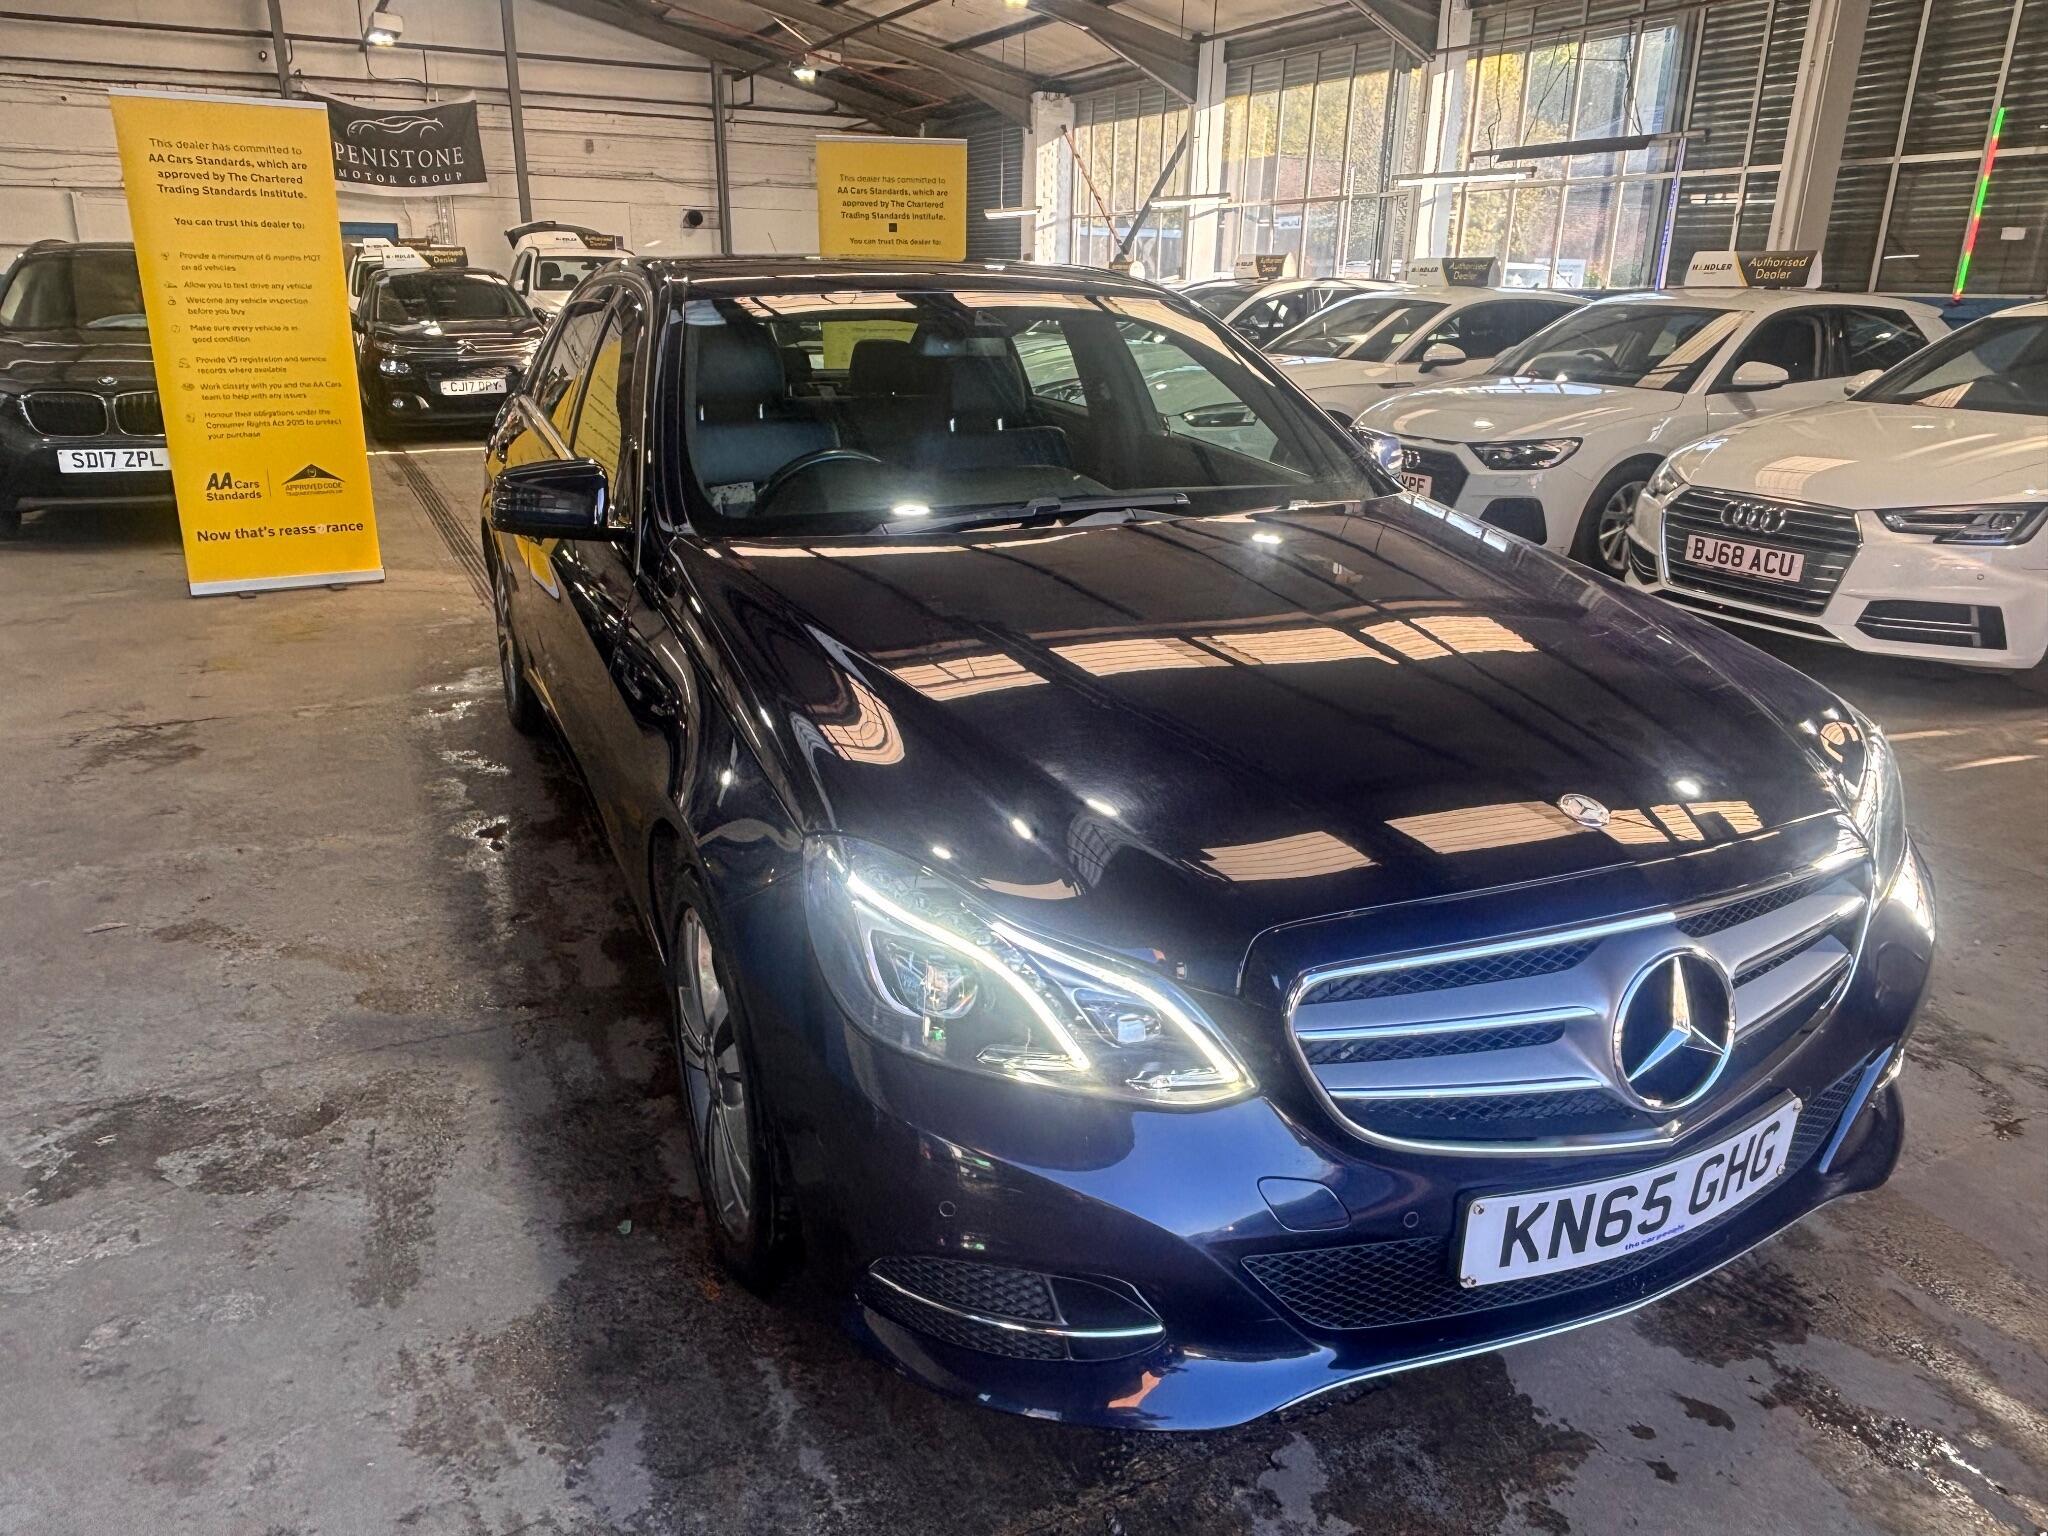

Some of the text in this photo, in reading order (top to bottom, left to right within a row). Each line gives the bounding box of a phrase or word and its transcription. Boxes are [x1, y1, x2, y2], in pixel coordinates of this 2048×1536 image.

[149, 138, 302, 155] This dealer has committed to
[149, 154, 165, 163] AA
[168, 155, 193, 165] Cars
[196, 156, 255, 168] Standards,
[257, 160, 289, 169] which
[334, 142, 464, 168] PENISTONE
[158, 171, 303, 184] approved by The Chartered
[338, 168, 463, 184] MOTOR GROUP
[840, 174, 855, 182] This
[157, 184, 308, 198] Trading Standards Institute.
[870, 188, 911, 196] Standards,
[842, 200, 878, 208] approved
[880, 200, 889, 209] by
[890, 200, 905, 208] The
[841, 212, 869, 220] Trading
[872, 212, 910, 220] Standards
[174, 218, 193, 226] You
[216, 219, 238, 227] trust
[261, 220, 290, 228] dealer
[180, 252, 209, 260] Provide
[304, 254, 320, 262] MOT
[1749, 256, 1808, 267] Authorised
[1756, 268, 1791, 280] Dealer
[231, 308, 245, 316] buy
[72, 451, 163, 468] SD17 ZPL
[206, 472, 260, 490] AA Cars
[206, 490, 262, 501] Standards
[197, 531, 231, 542] Now
[235, 526, 275, 539] that's
[1692, 538, 1795, 576] BJ68 ACU
[1499, 1120, 1780, 1268] KN65 GHG
